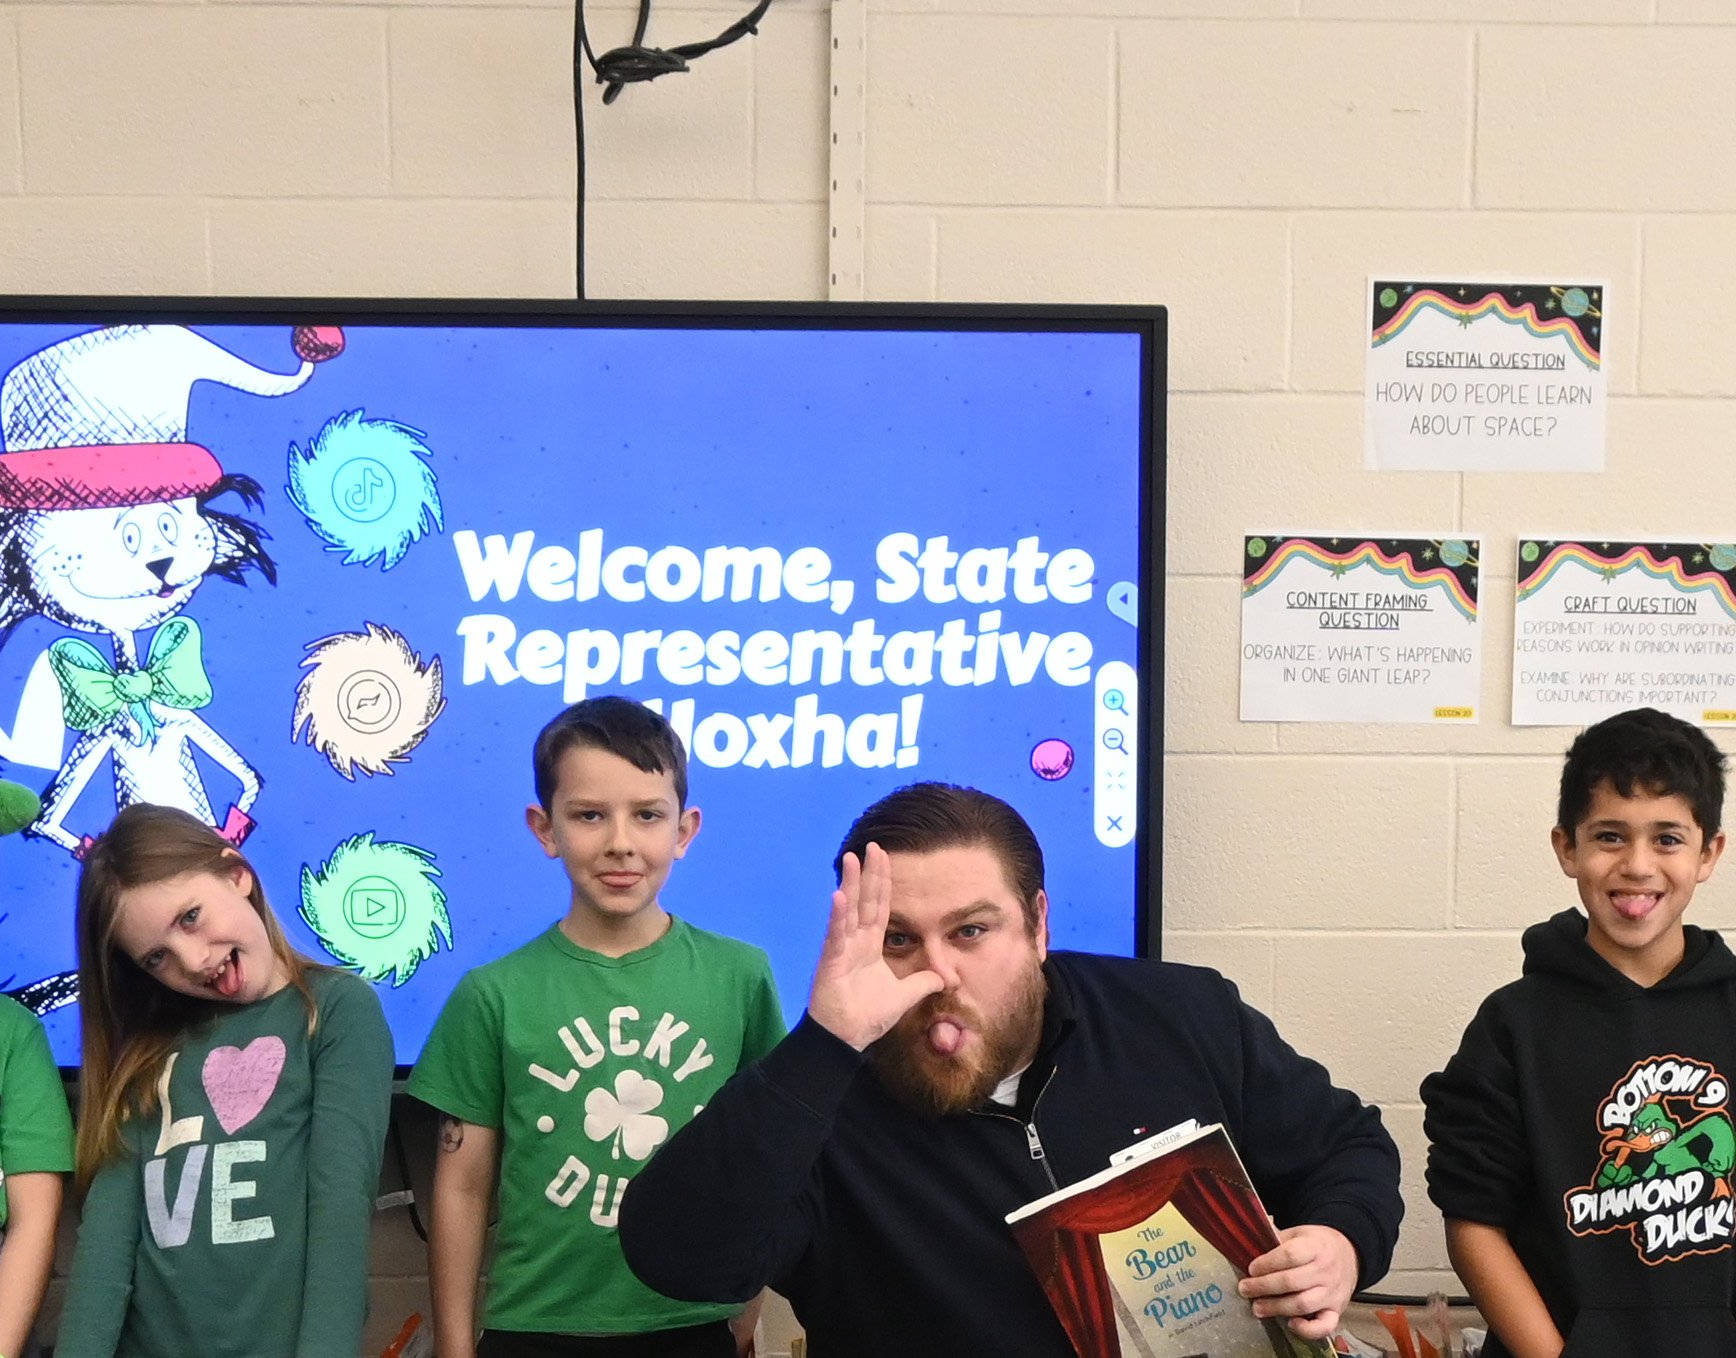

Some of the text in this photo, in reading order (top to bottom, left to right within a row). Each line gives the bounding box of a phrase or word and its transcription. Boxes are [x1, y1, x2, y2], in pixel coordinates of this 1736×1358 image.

[1406, 350, 1565, 369] ESSENTIAL QUESTION
[1376, 382, 1592, 405] HOW DO PEOPLE LEARN
[1410, 415, 1558, 437] ABOUT SPACE?
[453, 528, 1096, 614] Welcome, State
[1286, 591, 1428, 609] CONTENT FRAMING
[1564, 595, 1697, 614] CRAFT QUESTION
[1319, 611, 1400, 628] QUESTION
[457, 610, 1094, 704] Representative
[1327, 646, 1390, 662] WHAT'S
[1396, 646, 1472, 664] HAPPENING
[1283, 667, 1431, 685] IN ONE GIANT LEAP?
[529, 1005, 715, 1093] LUCKY
[1603, 1061, 1727, 1128] BOTTOM 9
[1150, 1131, 1182, 1151] VISITOR
[1569, 1170, 1705, 1225] DIAMOND
[1137, 1227, 1164, 1243] The
[1125, 1240, 1197, 1281] Bear
[1153, 1268, 1195, 1294] and the
[1143, 1283, 1223, 1329] Piano
